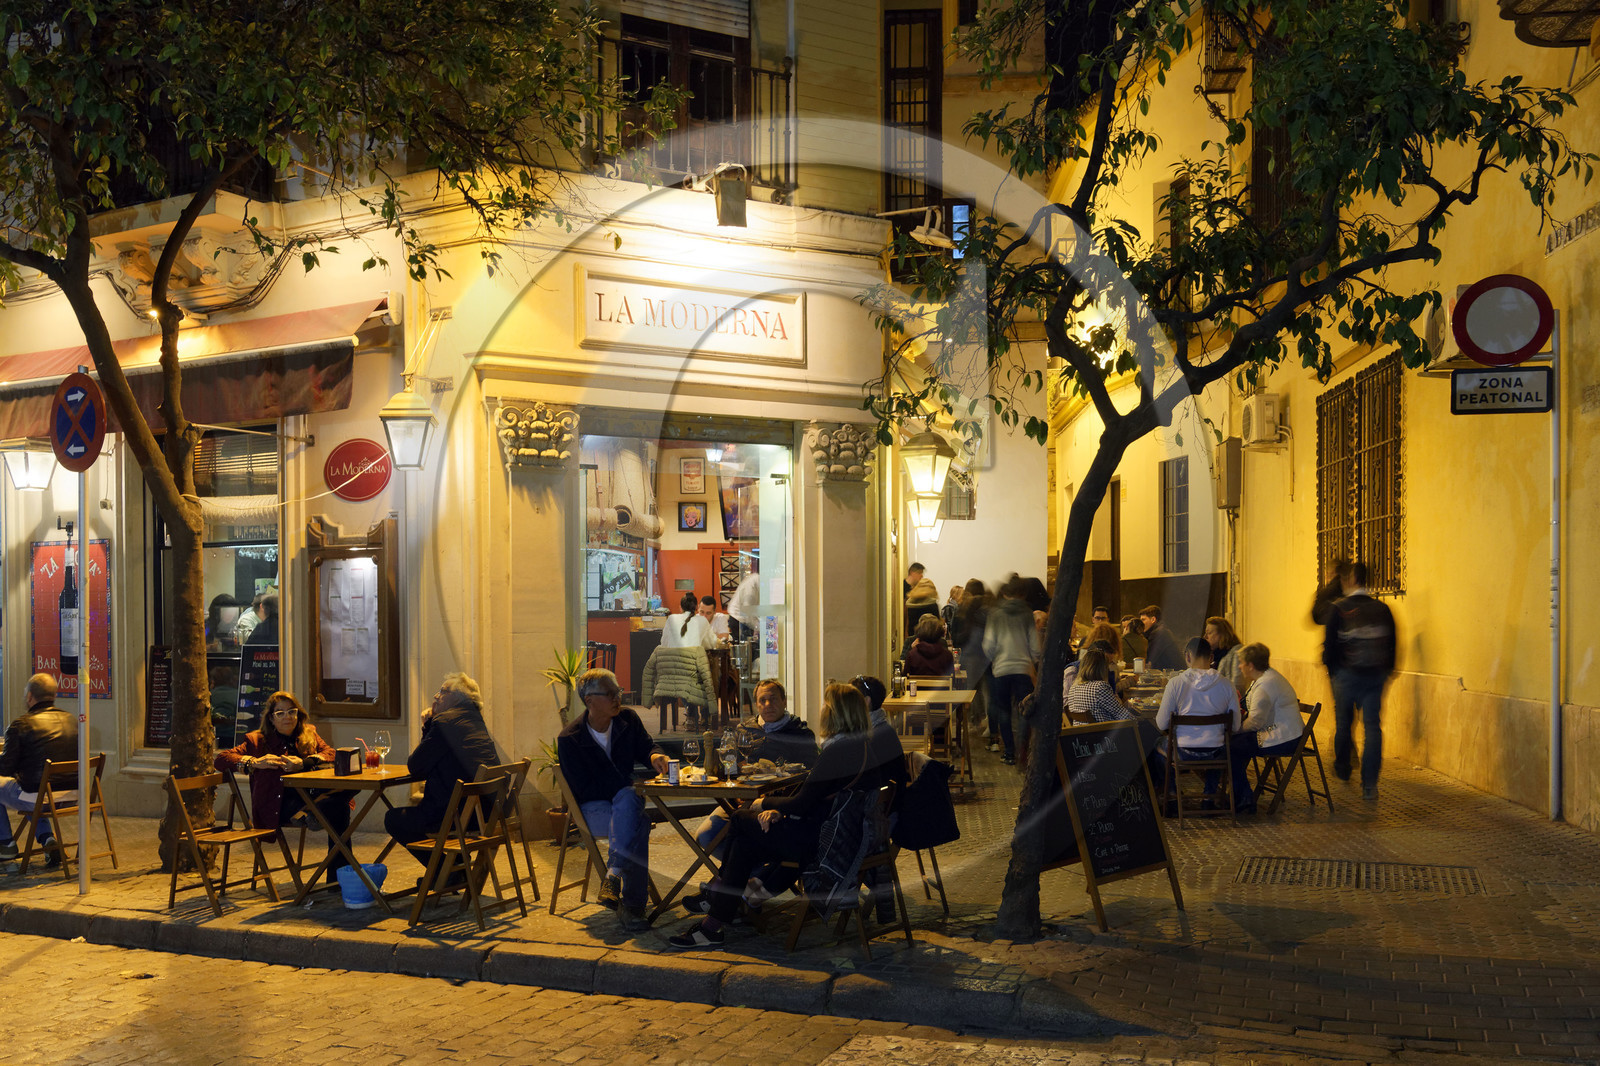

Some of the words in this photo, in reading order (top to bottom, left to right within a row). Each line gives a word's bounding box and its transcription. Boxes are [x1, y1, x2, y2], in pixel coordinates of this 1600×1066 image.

[595, 292, 635, 325] LA
[643, 297, 788, 341] MODERNA
[1479, 377, 1524, 389] ZONA
[1459, 392, 1543, 405] PEATONAL
[330, 465, 340, 476] LA
[342, 461, 386, 476] MODERNA
[37, 655, 58, 670] BAR
[53, 673, 105, 690] MODNA
